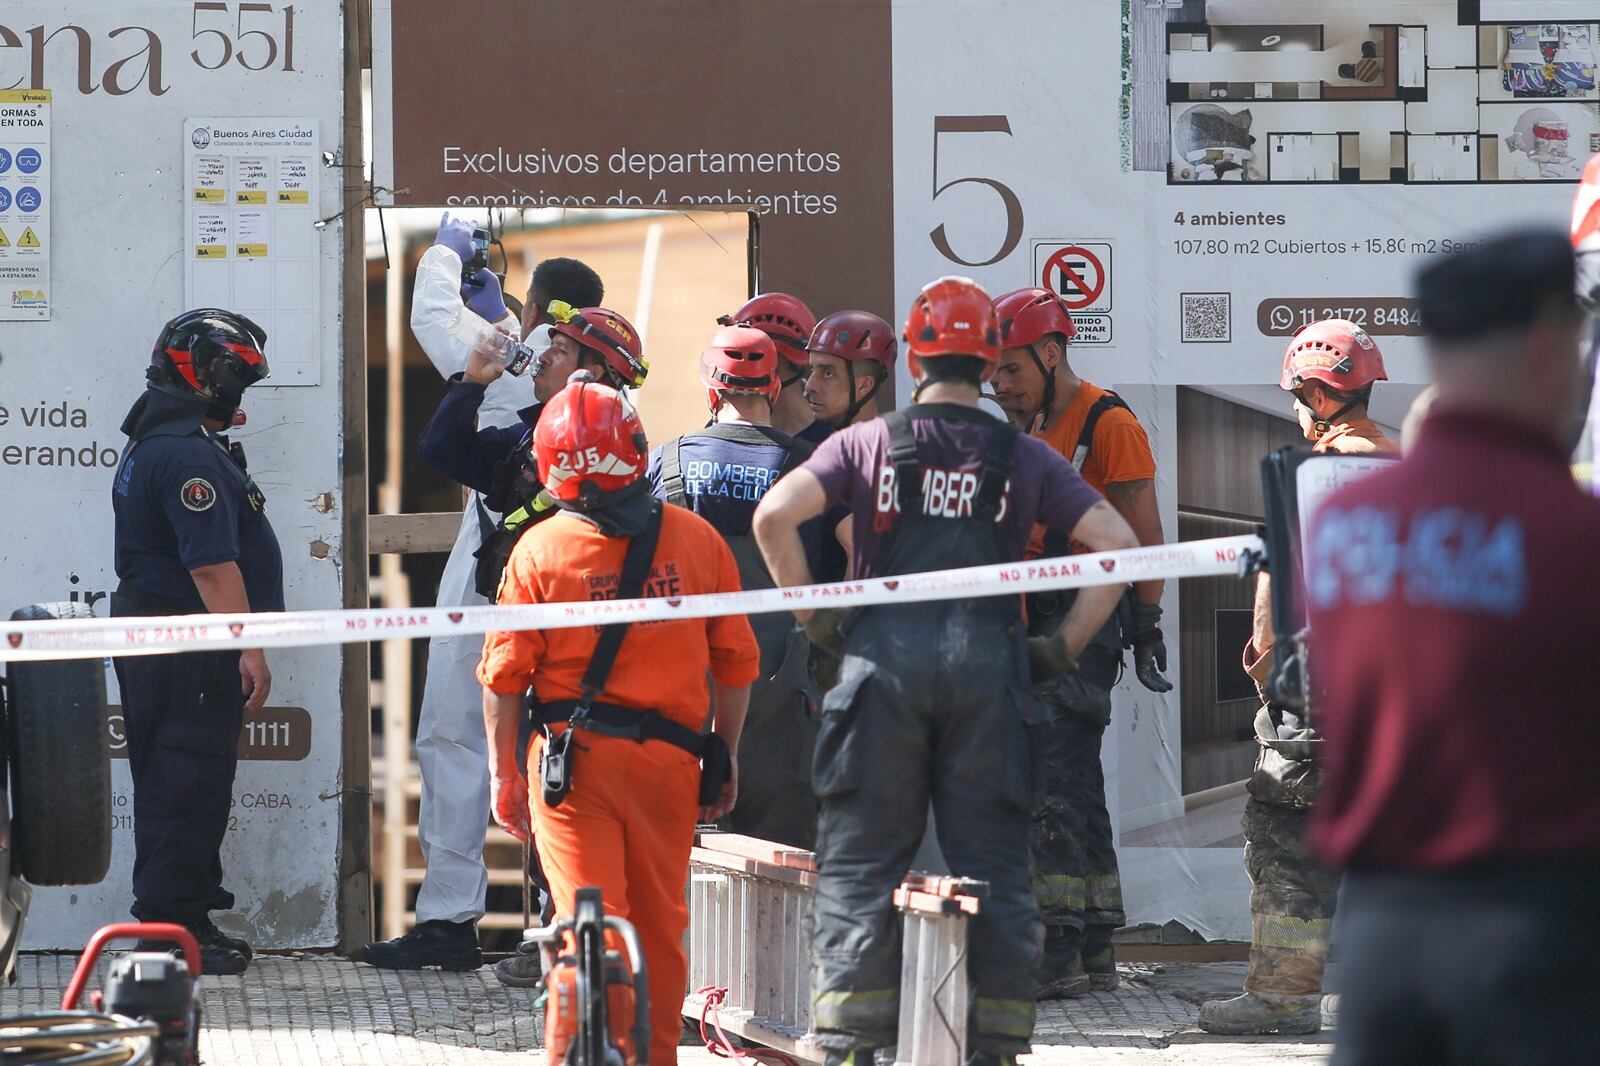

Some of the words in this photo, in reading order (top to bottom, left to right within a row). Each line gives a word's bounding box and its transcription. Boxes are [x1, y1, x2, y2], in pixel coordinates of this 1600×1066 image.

[190, 2, 296, 71] 551
[1, 109, 37, 117] ORMAS
[1, 119, 14, 127] EN
[17, 119, 44, 127] TODA
[213, 130, 249, 138] Buenos
[251, 130, 276, 138] Aires
[278, 130, 313, 138] Ciudad
[293, 140, 313, 148] Trabajo
[443, 147, 599, 175] Exclusivos
[608, 147, 841, 180] departamentos
[929, 115, 1025, 267] 5
[1174, 212, 1186, 226] 4
[1190, 212, 1286, 226] ambientes
[1174, 240, 1229, 256] 107,80
[1234, 240, 1260, 254] m2
[1264, 239, 1347, 254] Cubiertos
[1351, 242, 1361, 253] +
[1411, 239, 1437, 254] m2
[1300, 309, 1315, 325] 11
[1322, 308, 1367, 326] 2172
[1373, 309, 1423, 326] 8484
[605, 319, 632, 343] GER
[1294, 357, 1334, 367] GER
[20, 401, 87, 428] vida
[2, 441, 119, 468] erando
[557, 446, 601, 470] 2J5
[686, 479, 705, 495] DE
[707, 480, 729, 498] LA
[665, 563, 677, 576] DE
[1000, 569, 1021, 582] NO
[1028, 563, 1081, 579] PASAR
[1215, 549, 1237, 563] NO
[589, 574, 619, 589] GRUPO
[345, 618, 367, 630] NO
[374, 614, 429, 629] PASAR
[125, 629, 144, 643] NO
[155, 625, 209, 642] PASAR
[245, 721, 290, 746] 1111
[241, 793, 292, 808] CABA
